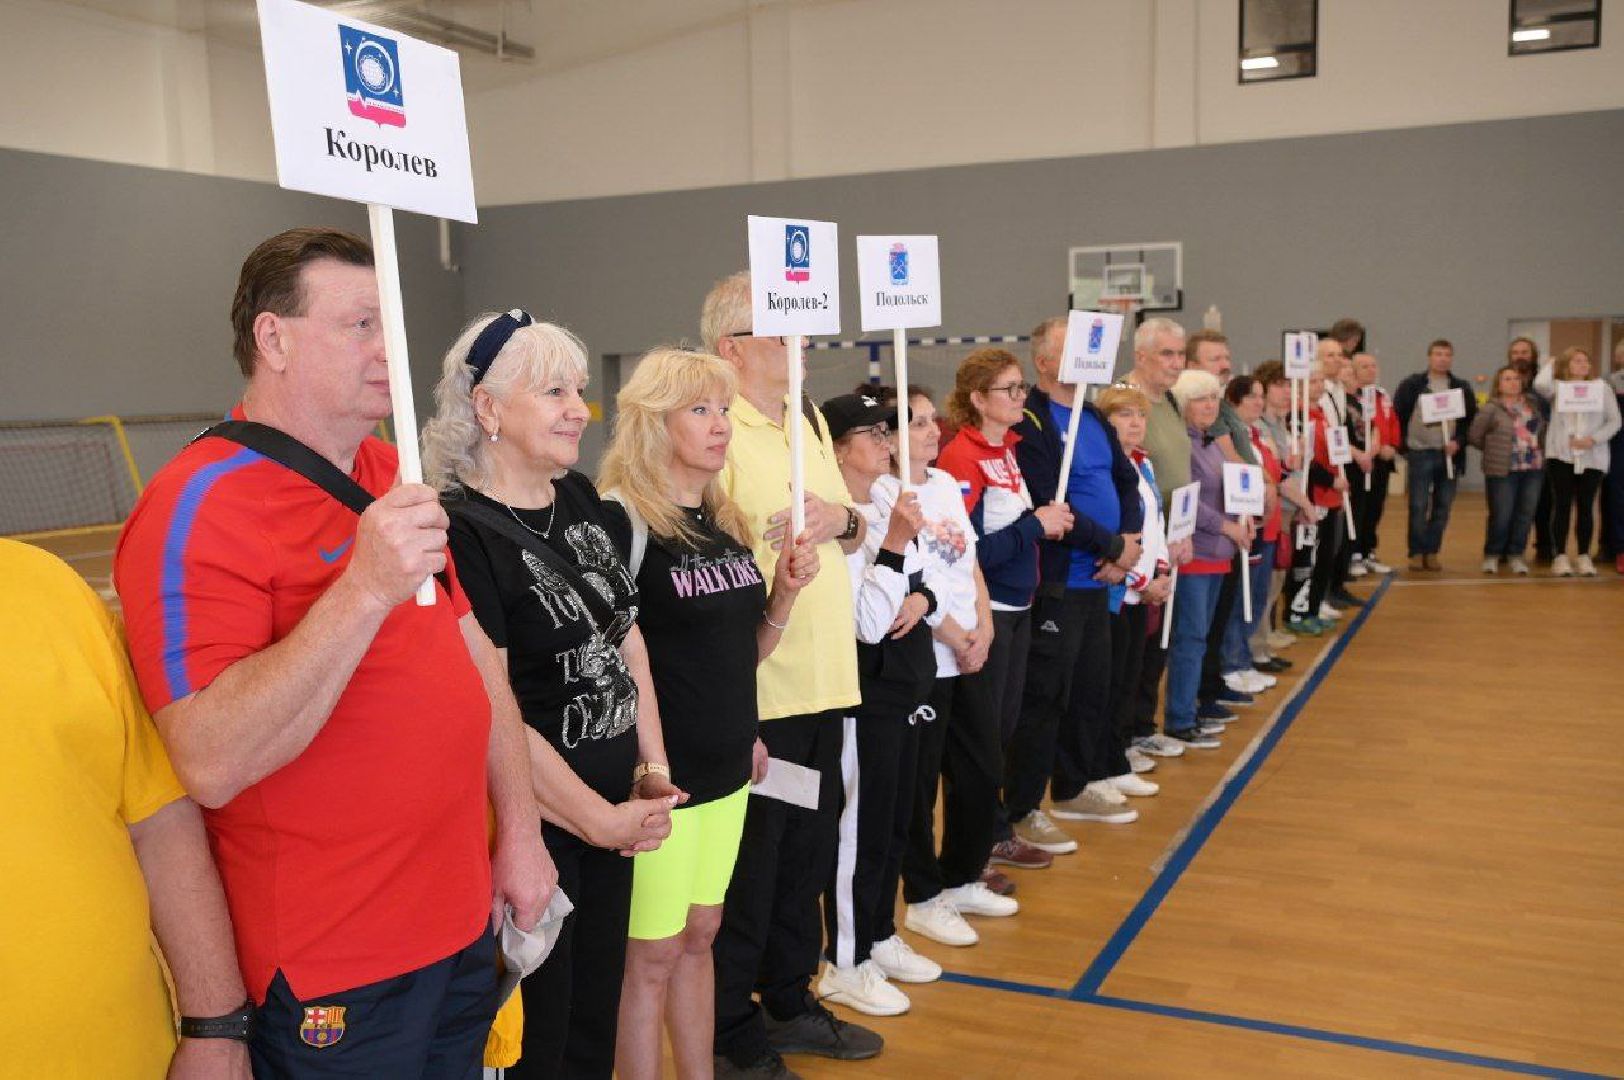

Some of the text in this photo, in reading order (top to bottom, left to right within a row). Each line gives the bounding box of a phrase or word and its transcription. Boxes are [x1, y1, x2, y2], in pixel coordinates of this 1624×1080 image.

[324, 127, 438, 178] Королев
[767, 292, 828, 315] Королев-2
[876, 292, 929, 306] Подольск
[670, 565, 731, 598] WALK
